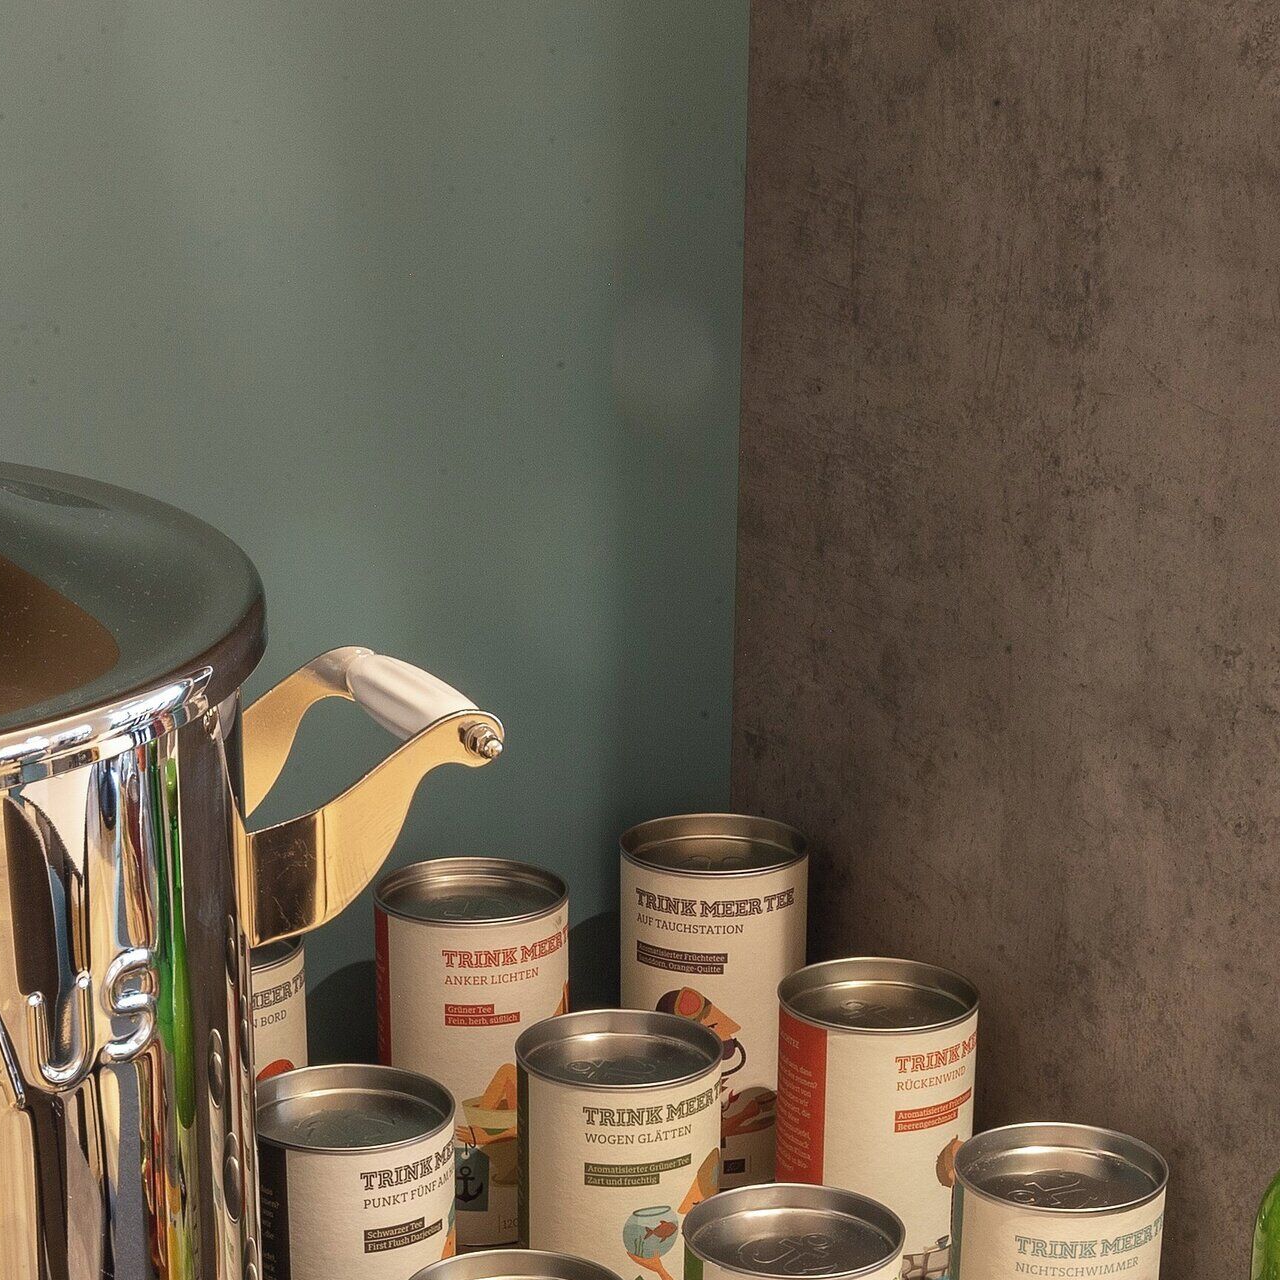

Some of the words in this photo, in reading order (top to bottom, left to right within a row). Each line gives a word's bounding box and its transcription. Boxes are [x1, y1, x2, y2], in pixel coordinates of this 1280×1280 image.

[636, 887, 697, 917] TRINK
[700, 897, 763, 918] MEER
[764, 887, 795, 912] TEE
[636, 912, 654, 926] AUF
[655, 918, 744, 935] TAUCHSTATION
[441, 947, 518, 969] TRINK
[520, 931, 563, 962] MEER
[444, 974, 489, 987] ANKER
[491, 966, 540, 985] LICHTEN
[260, 1009, 287, 1028] BORD
[447, 1005, 476, 1016] Grüner
[477, 1005, 493, 1015] Tee
[894, 1043, 961, 1074] TRINK
[896, 1065, 966, 1092] RÜCKENWIND
[582, 1105, 663, 1127] TRINK
[666, 1088, 713, 1123] MEER
[584, 1132, 635, 1145] WOGEN
[637, 1124, 693, 1145] GLÄTTEN
[360, 1154, 434, 1191] TRINK
[587, 1164, 648, 1175] Aromatisierter
[363, 1191, 409, 1210] PUNKT
[410, 1179, 437, 1201] FÜNF
[367, 1224, 410, 1240] Schwarzer
[1015, 1235, 1098, 1259] TRINK
[1100, 1224, 1153, 1257] MEER
[368, 1241, 388, 1252] First
[388, 1236, 410, 1249] Flush
[1014, 1256, 1140, 1278] NICHTSCHWIMMER
